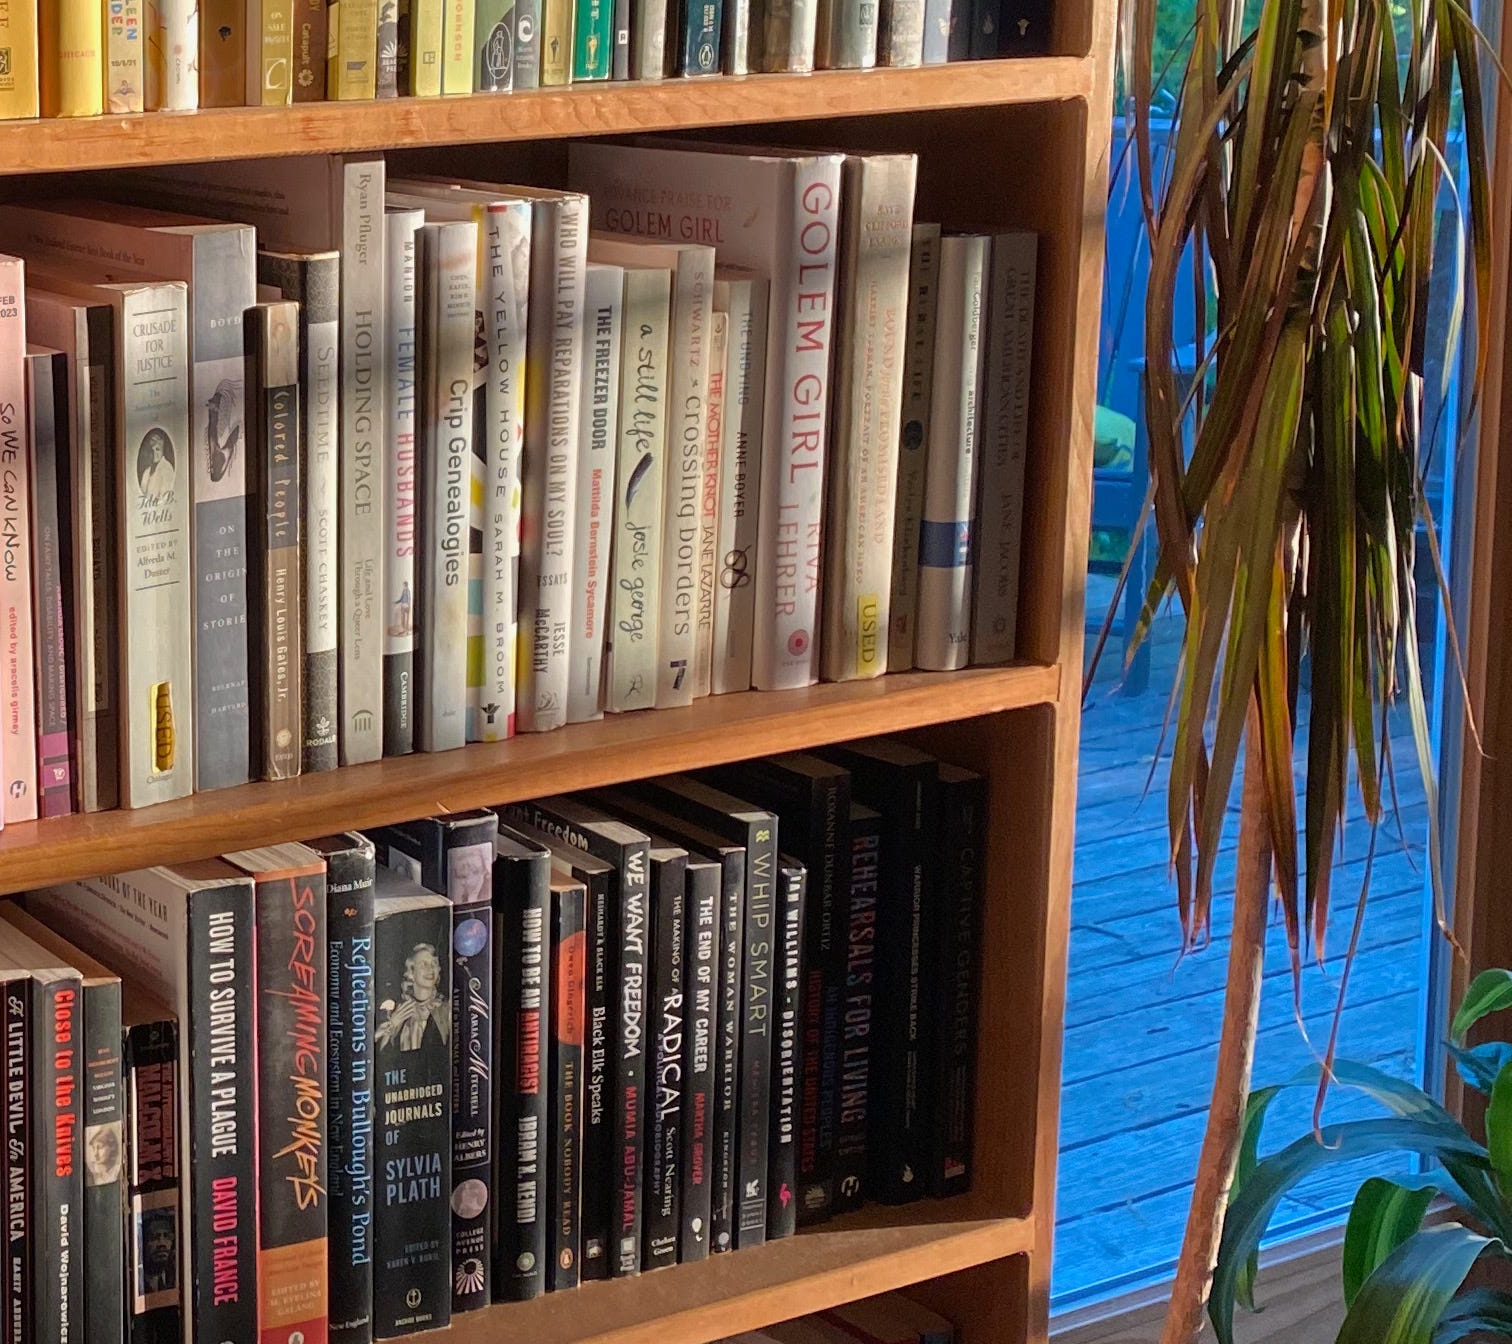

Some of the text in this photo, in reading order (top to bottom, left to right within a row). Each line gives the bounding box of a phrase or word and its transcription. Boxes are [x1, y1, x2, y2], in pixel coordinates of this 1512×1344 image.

[353, 310, 373, 516] HOLDING SPACE
[545, 213, 580, 557] WHO WILL PAY REPARATIONS ON MY SOUL?
[591, 306, 613, 450] THE FREEZER DOOR
[790, 182, 832, 484] GOLEM GIRL
[441, 379, 467, 586] Crip Genealogies
[674, 395, 702, 637] crossing borders
[773, 504, 802, 617] LEHRER
[156, 689, 173, 760] USED
[860, 603, 877, 664] USED
[208, 912, 238, 1157] HOW TO SURVIVE A PLAGUE
[623, 851, 644, 1059] WE WANT FREEDOM
[54, 989, 75, 1176] Close to the Knives
[589, 1007, 605, 1124] Black Elk Speaks
[660, 994, 683, 1120] RADICAL
[211, 1176, 238, 1305] DAVID FRANCE
